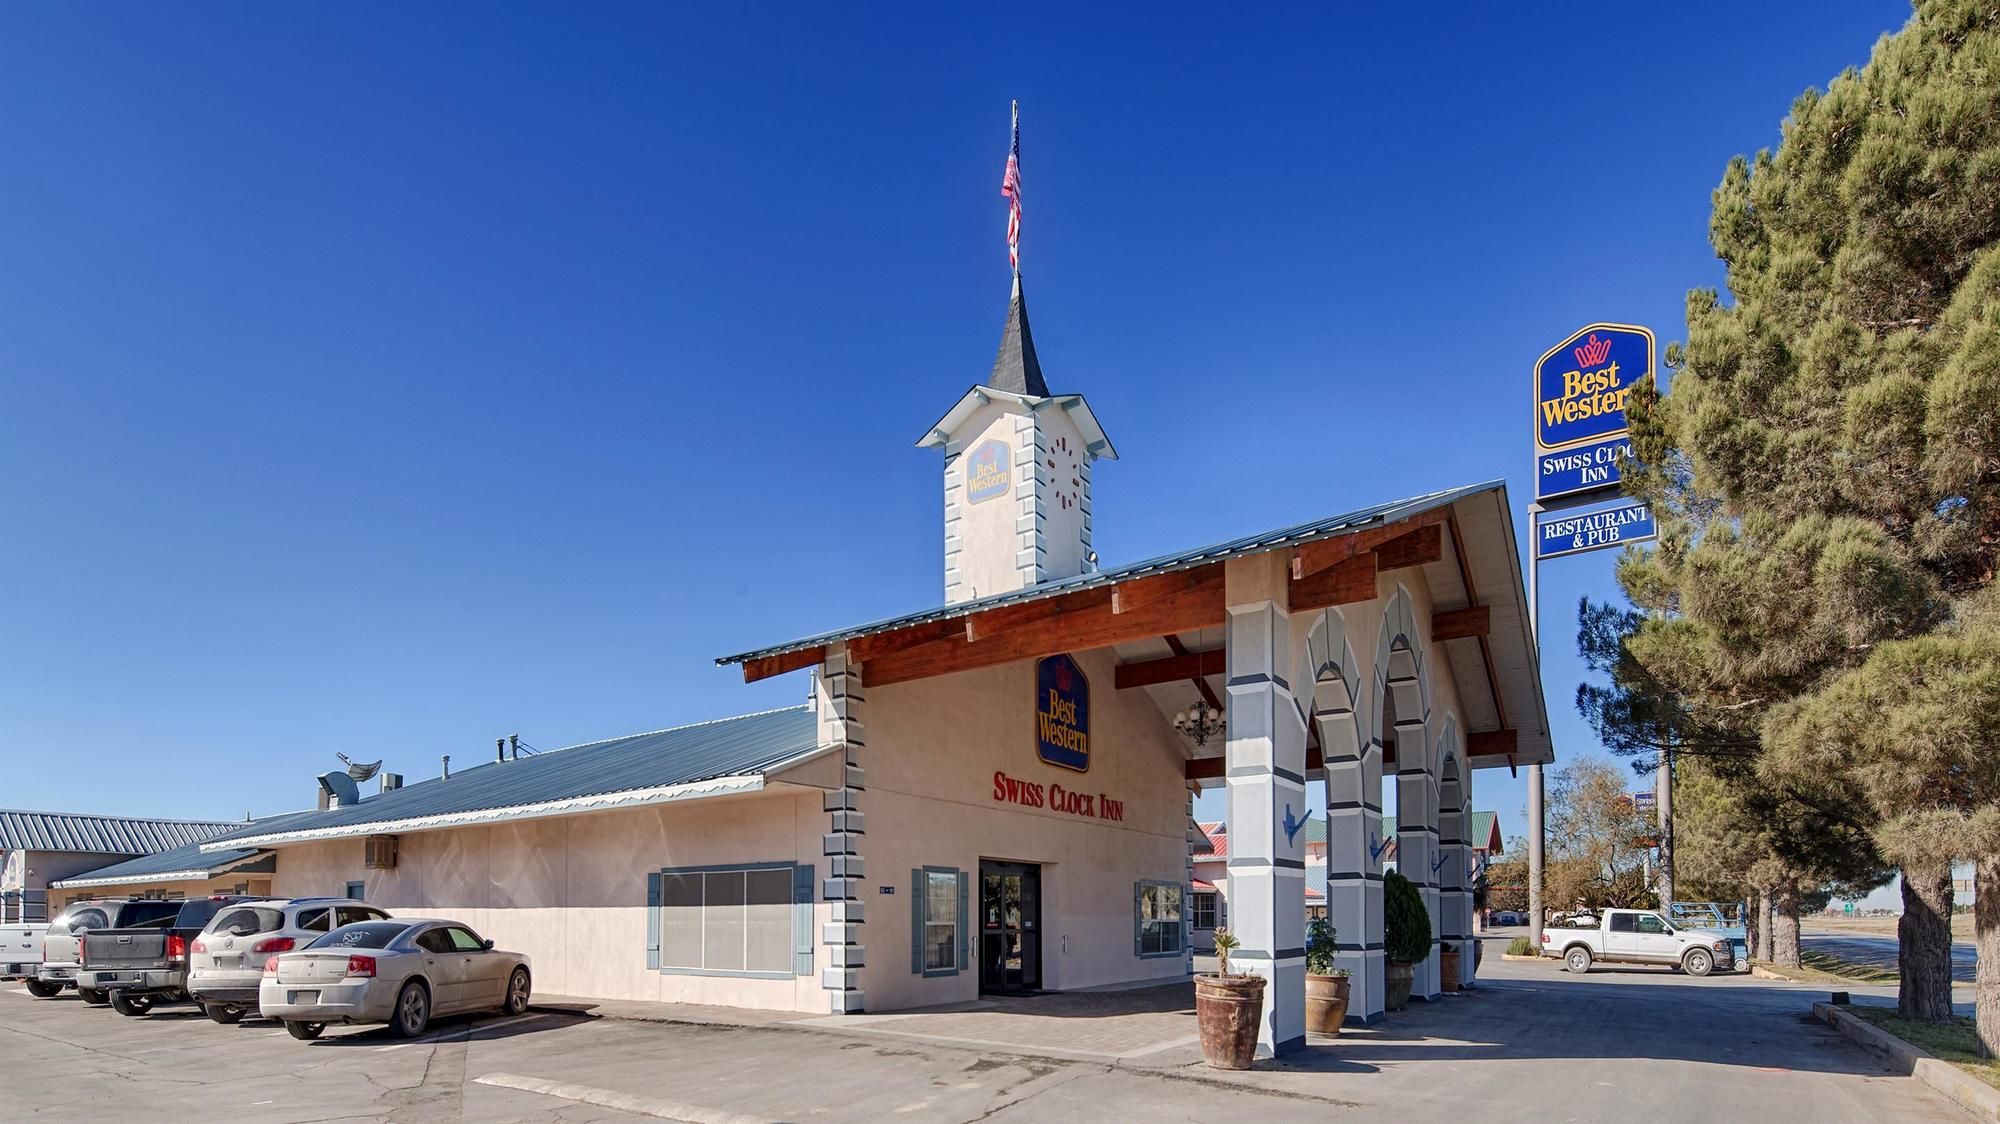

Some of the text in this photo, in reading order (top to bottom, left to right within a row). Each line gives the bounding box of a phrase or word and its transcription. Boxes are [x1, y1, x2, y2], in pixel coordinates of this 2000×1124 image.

[1562, 360, 1620, 400] Best
[1541, 387, 1630, 427] Wester
[969, 472, 1008, 492] Western
[976, 461, 997, 480] Best
[1544, 507, 1647, 540] RESTAURANT
[1572, 526, 1620, 549] & PUB
[1049, 688, 1077, 726] Best
[1039, 711, 1088, 754] Western
